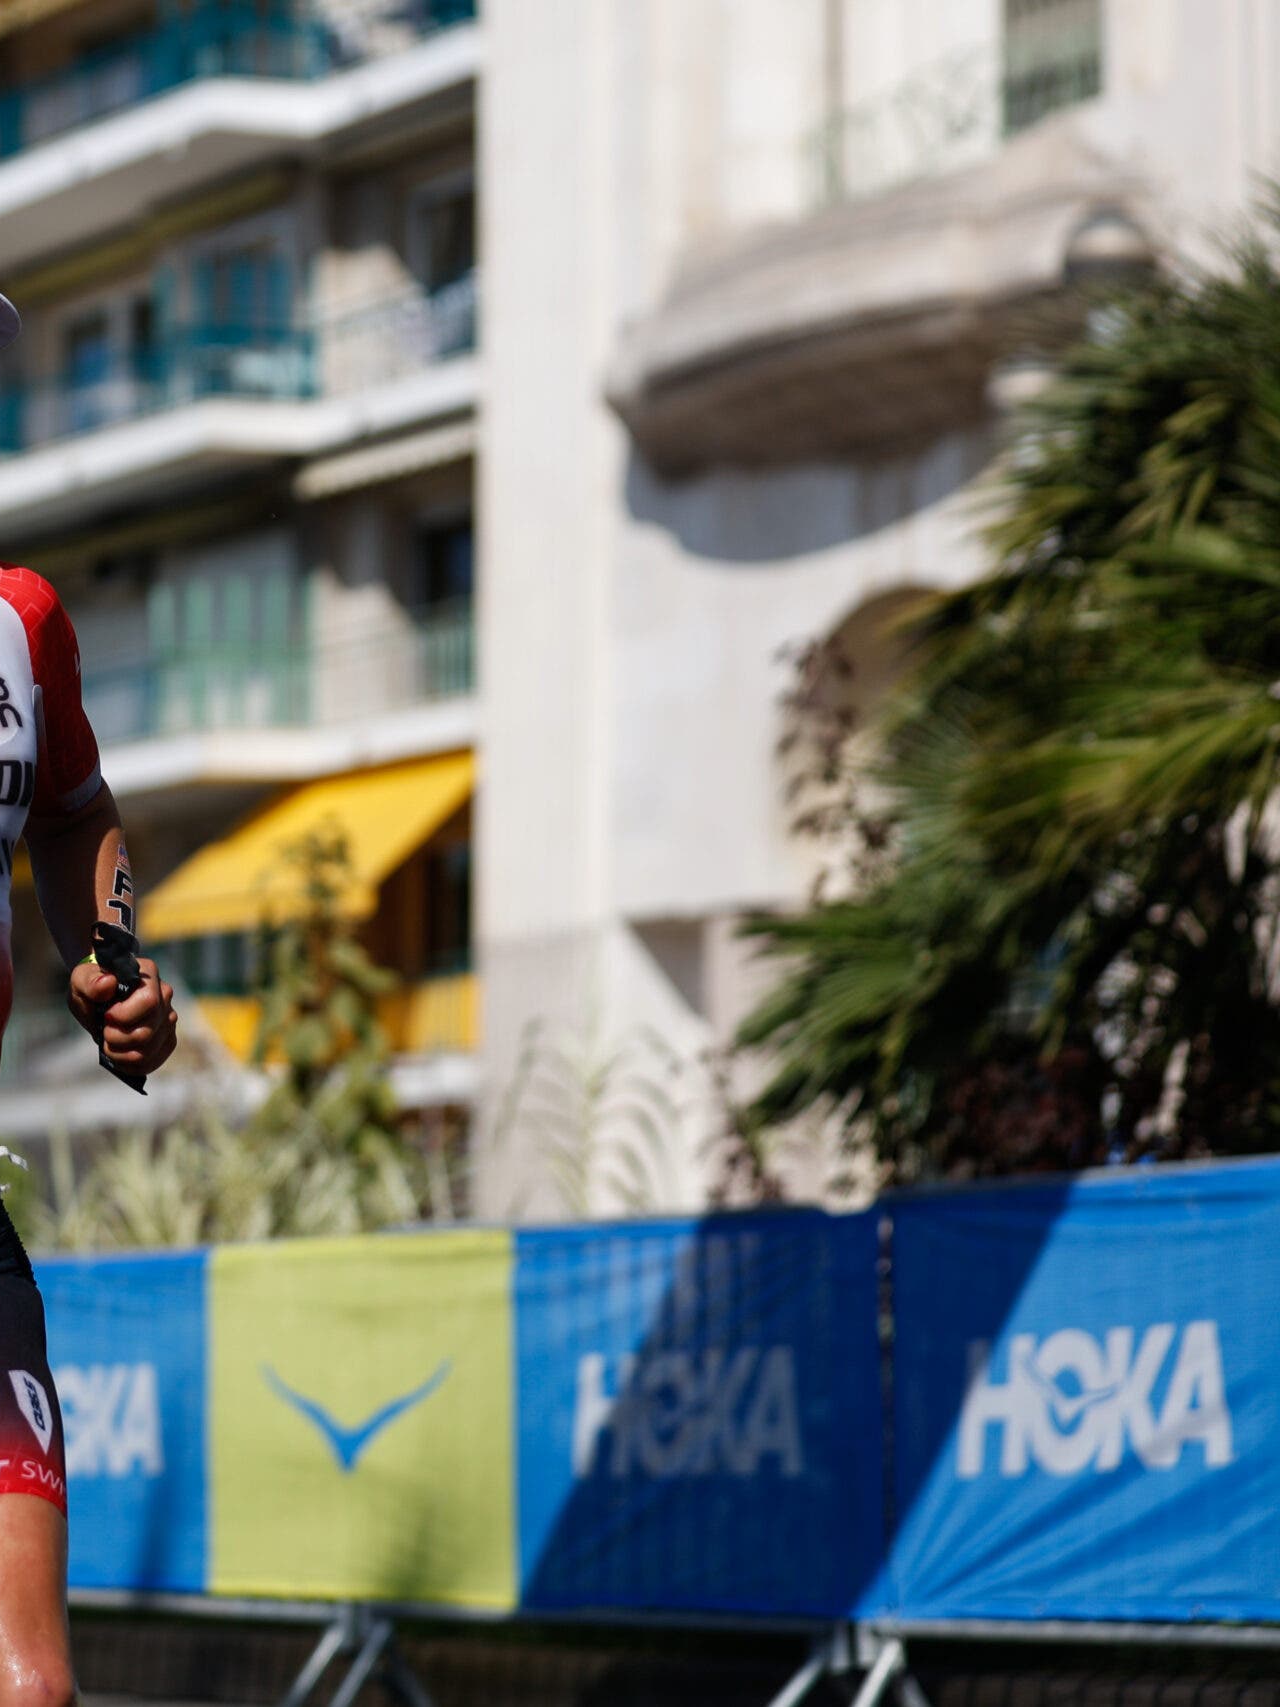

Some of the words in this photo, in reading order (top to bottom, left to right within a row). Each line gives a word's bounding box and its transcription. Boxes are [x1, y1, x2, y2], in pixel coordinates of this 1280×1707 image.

[58, 1361, 165, 1479] OKA
[571, 1346, 804, 1479] HOKA
[956, 1320, 1233, 1479] HOKA
